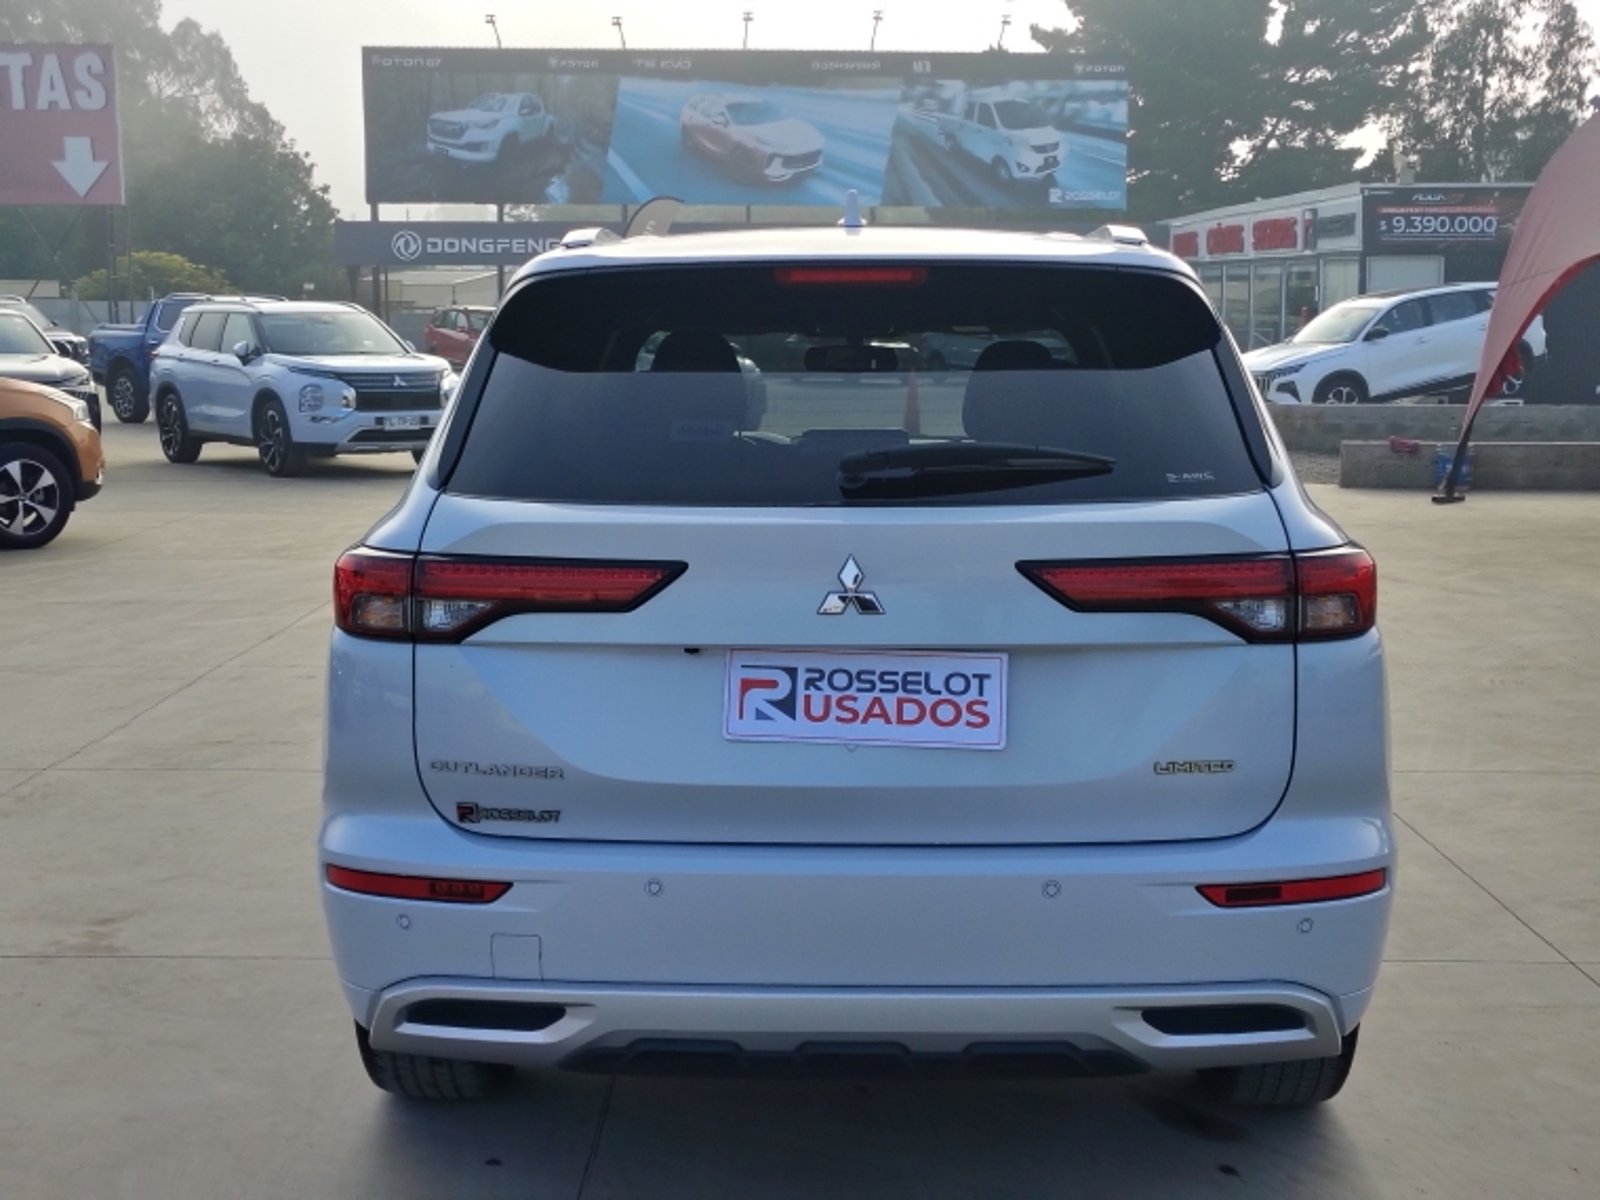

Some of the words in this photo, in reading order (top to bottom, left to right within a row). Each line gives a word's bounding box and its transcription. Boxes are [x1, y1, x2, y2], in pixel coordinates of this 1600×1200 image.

[1392, 216, 1497, 233] 9.390.000
[804, 668, 992, 697] ROSSELOT
[803, 695, 991, 730] USADOS
[429, 760, 565, 780] OUTLANDER
[1153, 760, 1236, 775] LIMITED
